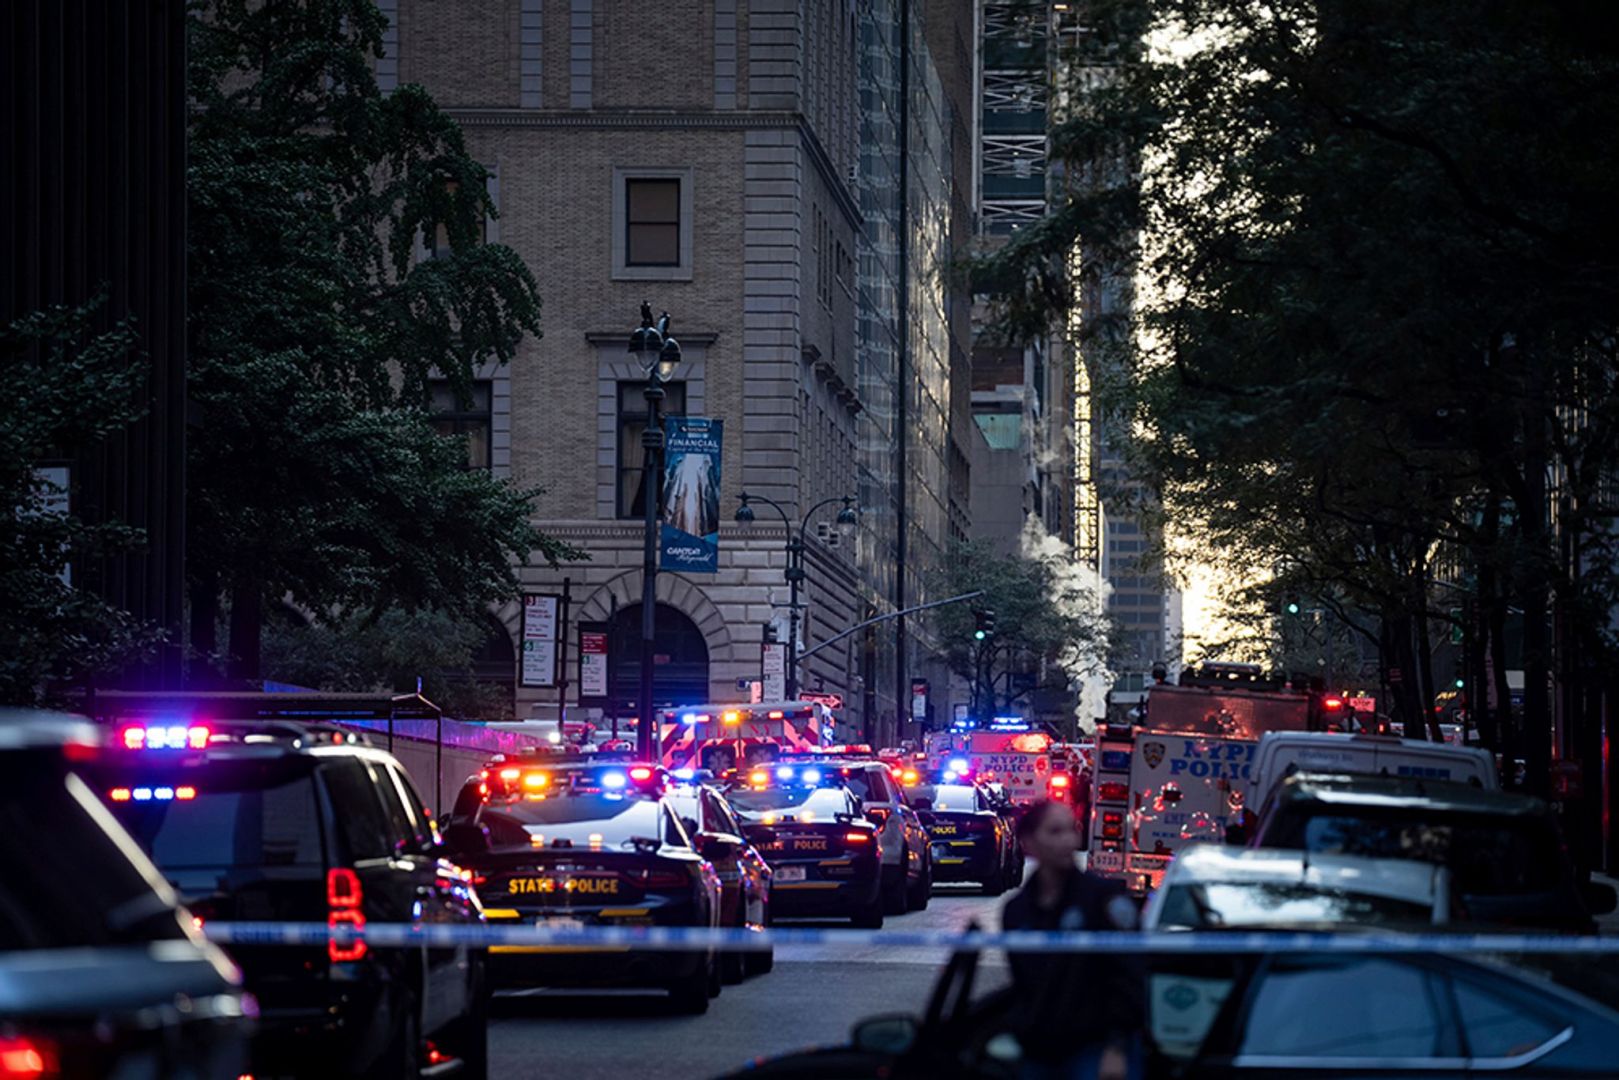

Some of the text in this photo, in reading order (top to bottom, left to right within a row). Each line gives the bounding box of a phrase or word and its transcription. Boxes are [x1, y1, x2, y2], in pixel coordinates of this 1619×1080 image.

[667, 438, 719, 448] FINANCIAL
[991, 755, 1028, 764] NYPD
[984, 764, 1034, 773] POLICE
[1169, 759, 1250, 780] POLIC
[793, 839, 828, 851] POLICE
[508, 878, 619, 894] STATE POLICE
